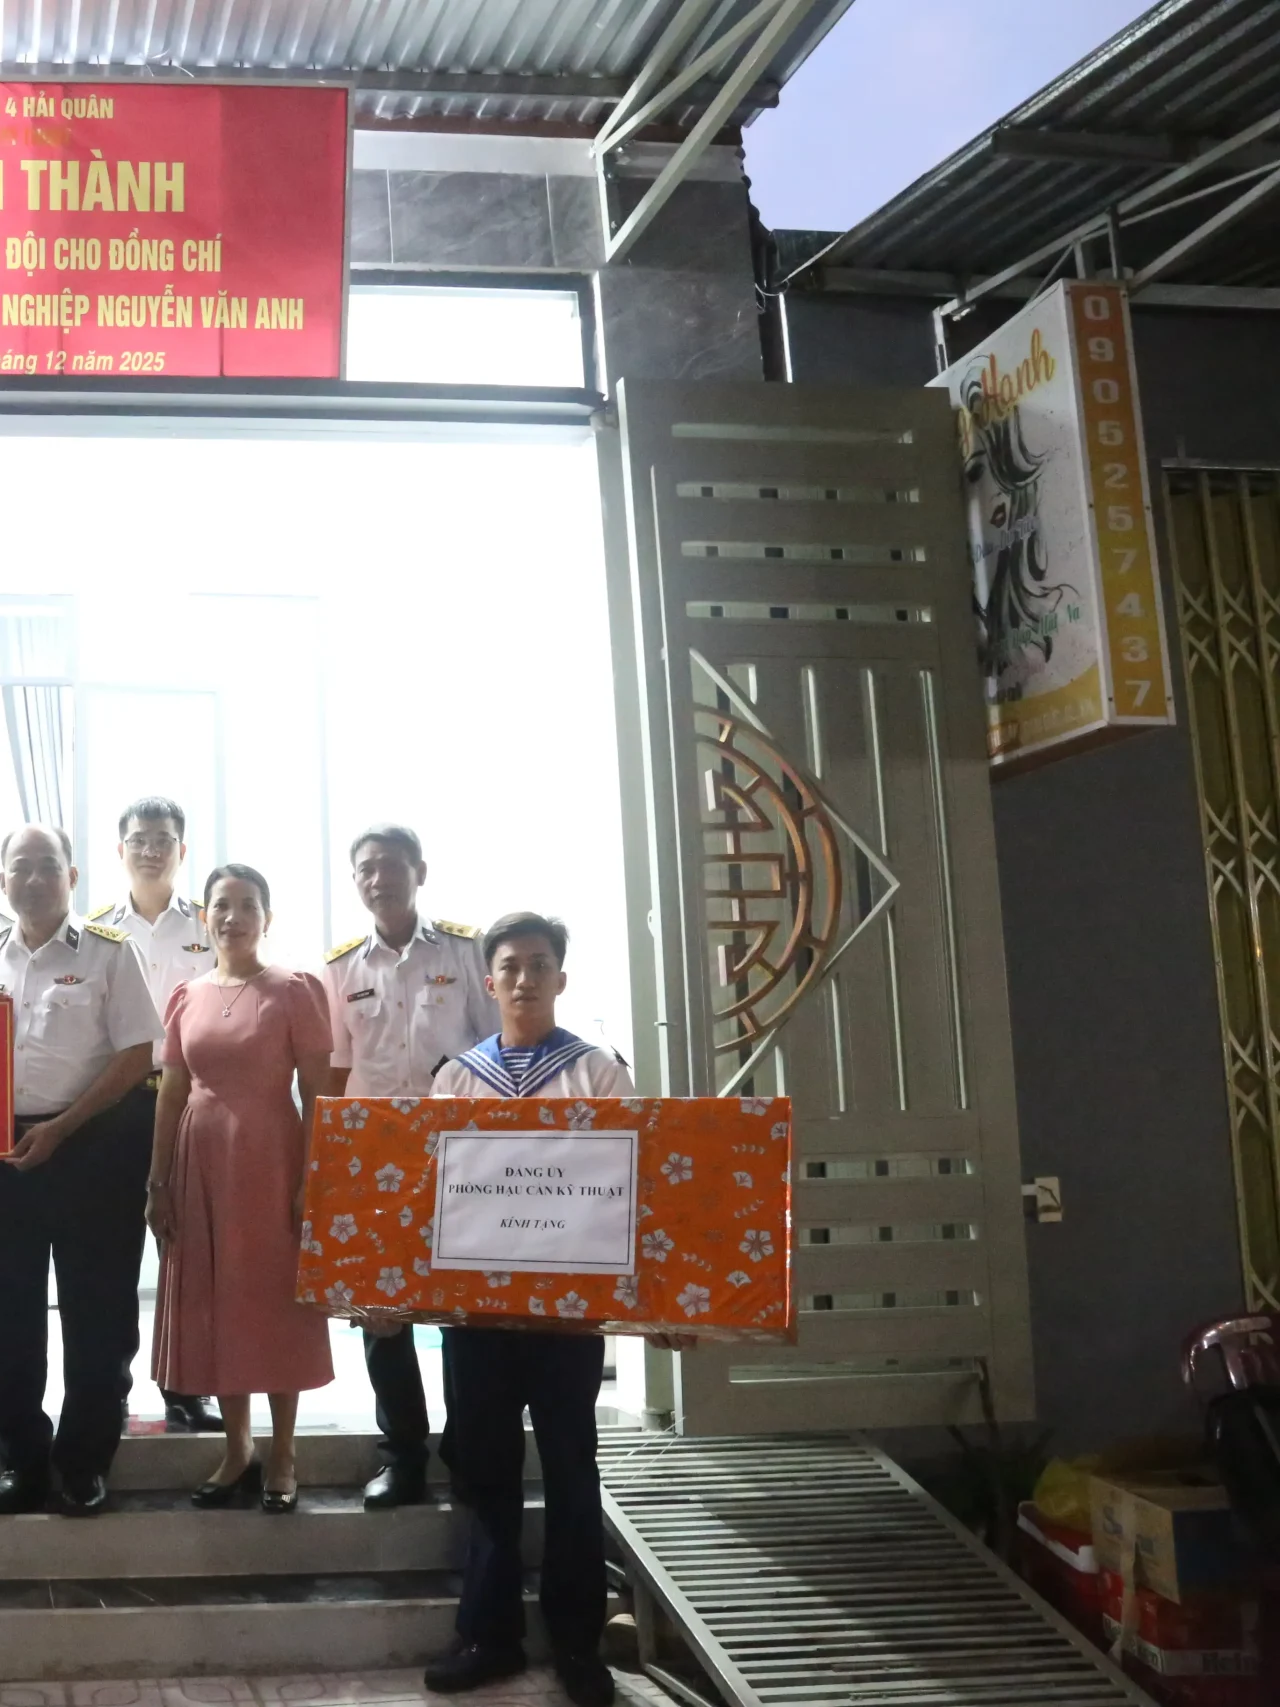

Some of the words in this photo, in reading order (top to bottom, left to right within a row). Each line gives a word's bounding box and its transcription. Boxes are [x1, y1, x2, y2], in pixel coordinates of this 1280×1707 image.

[5, 97, 17, 117] 4
[23, 90, 54, 118] HẢI
[61, 92, 114, 120] QUÂN
[20, 149, 185, 212] THÀNH
[5, 230, 46, 277] ĐỘI
[54, 237, 102, 271] CHO
[108, 227, 174, 273] ĐỒNG
[182, 232, 223, 273] CHÍ
[2, 287, 90, 334] NGHIỆP
[97, 284, 193, 328] NGUYỄN
[200, 290, 247, 329] VĂN
[254, 297, 304, 330] ANH
[46, 351, 67, 371] 12
[72, 351, 113, 371] năm
[119, 351, 165, 372] 2025
